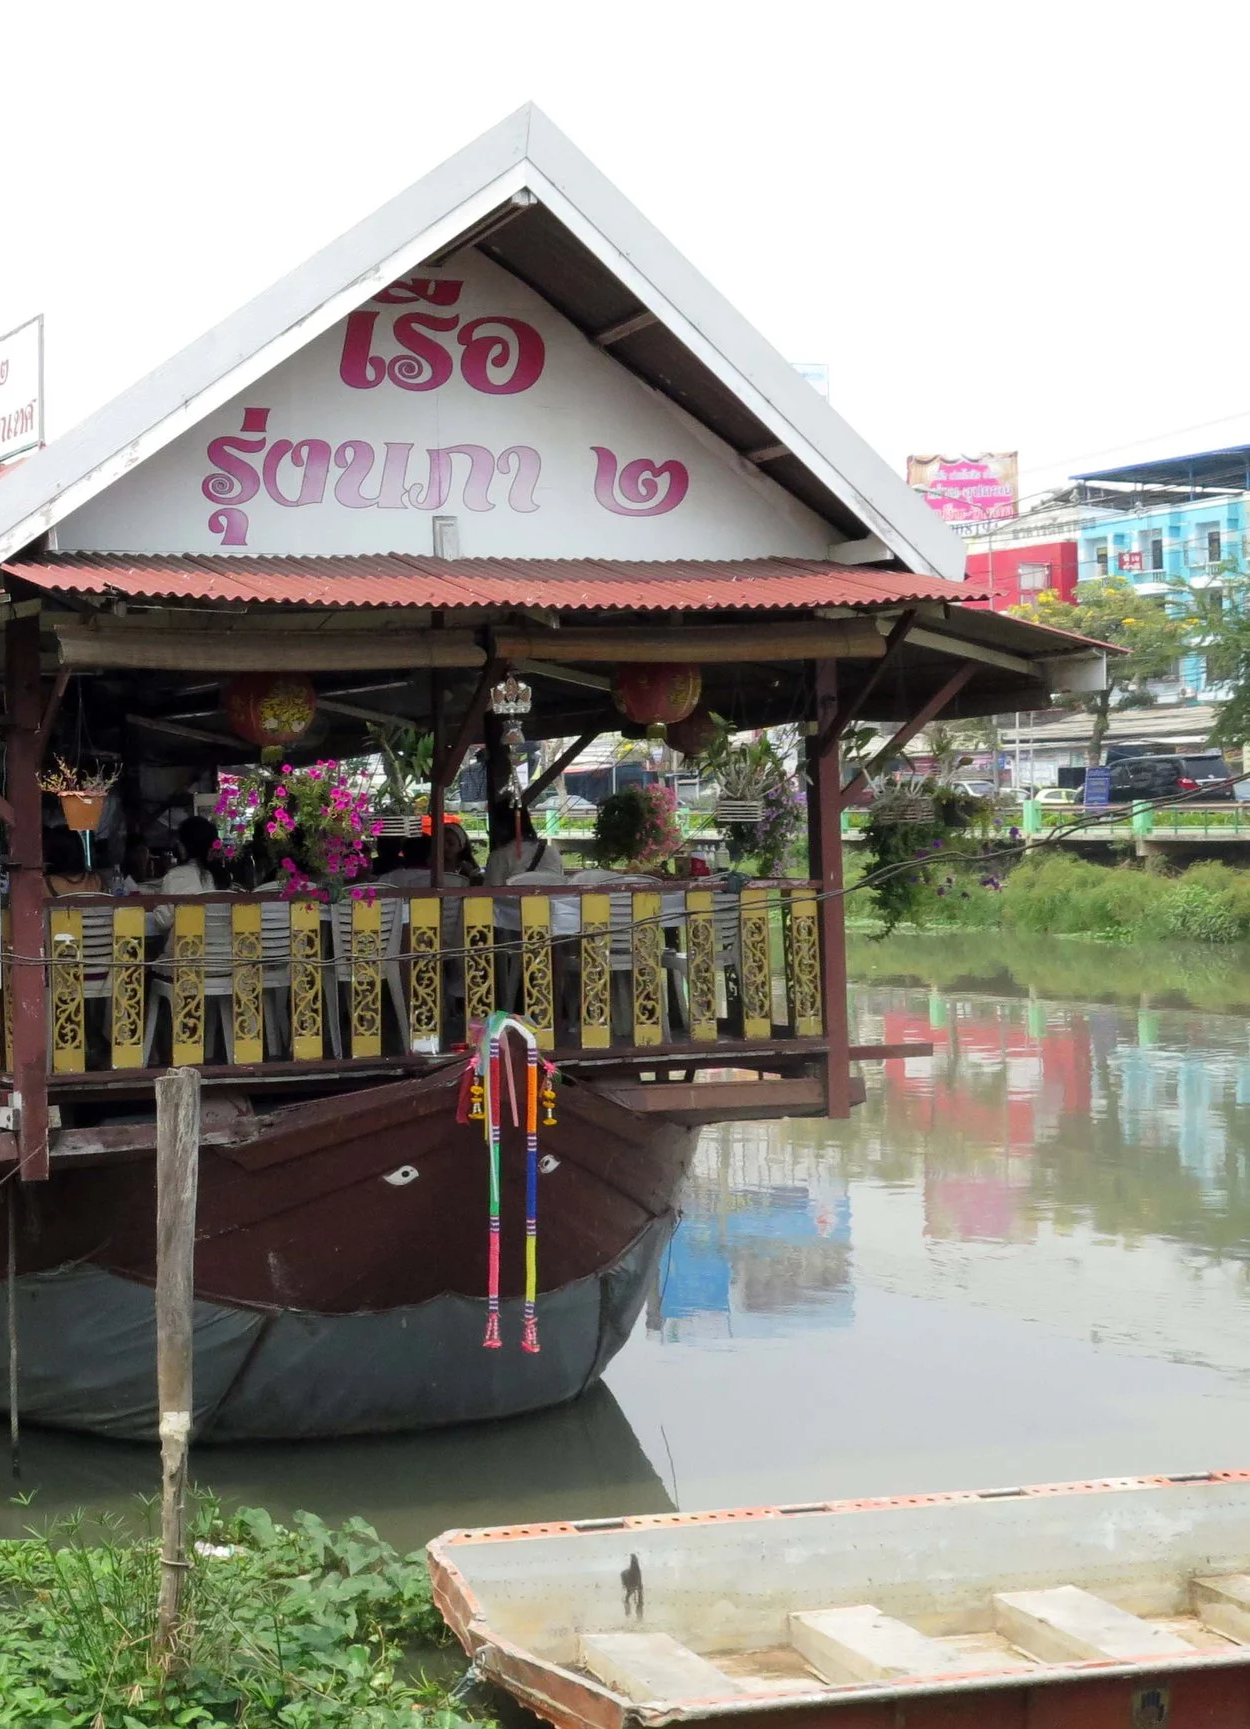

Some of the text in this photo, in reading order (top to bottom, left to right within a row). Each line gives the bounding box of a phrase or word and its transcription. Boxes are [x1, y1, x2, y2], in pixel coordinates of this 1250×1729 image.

[339, 278, 547, 396] เรือ
[201, 407, 691, 547] รุ่งนภา ๒
